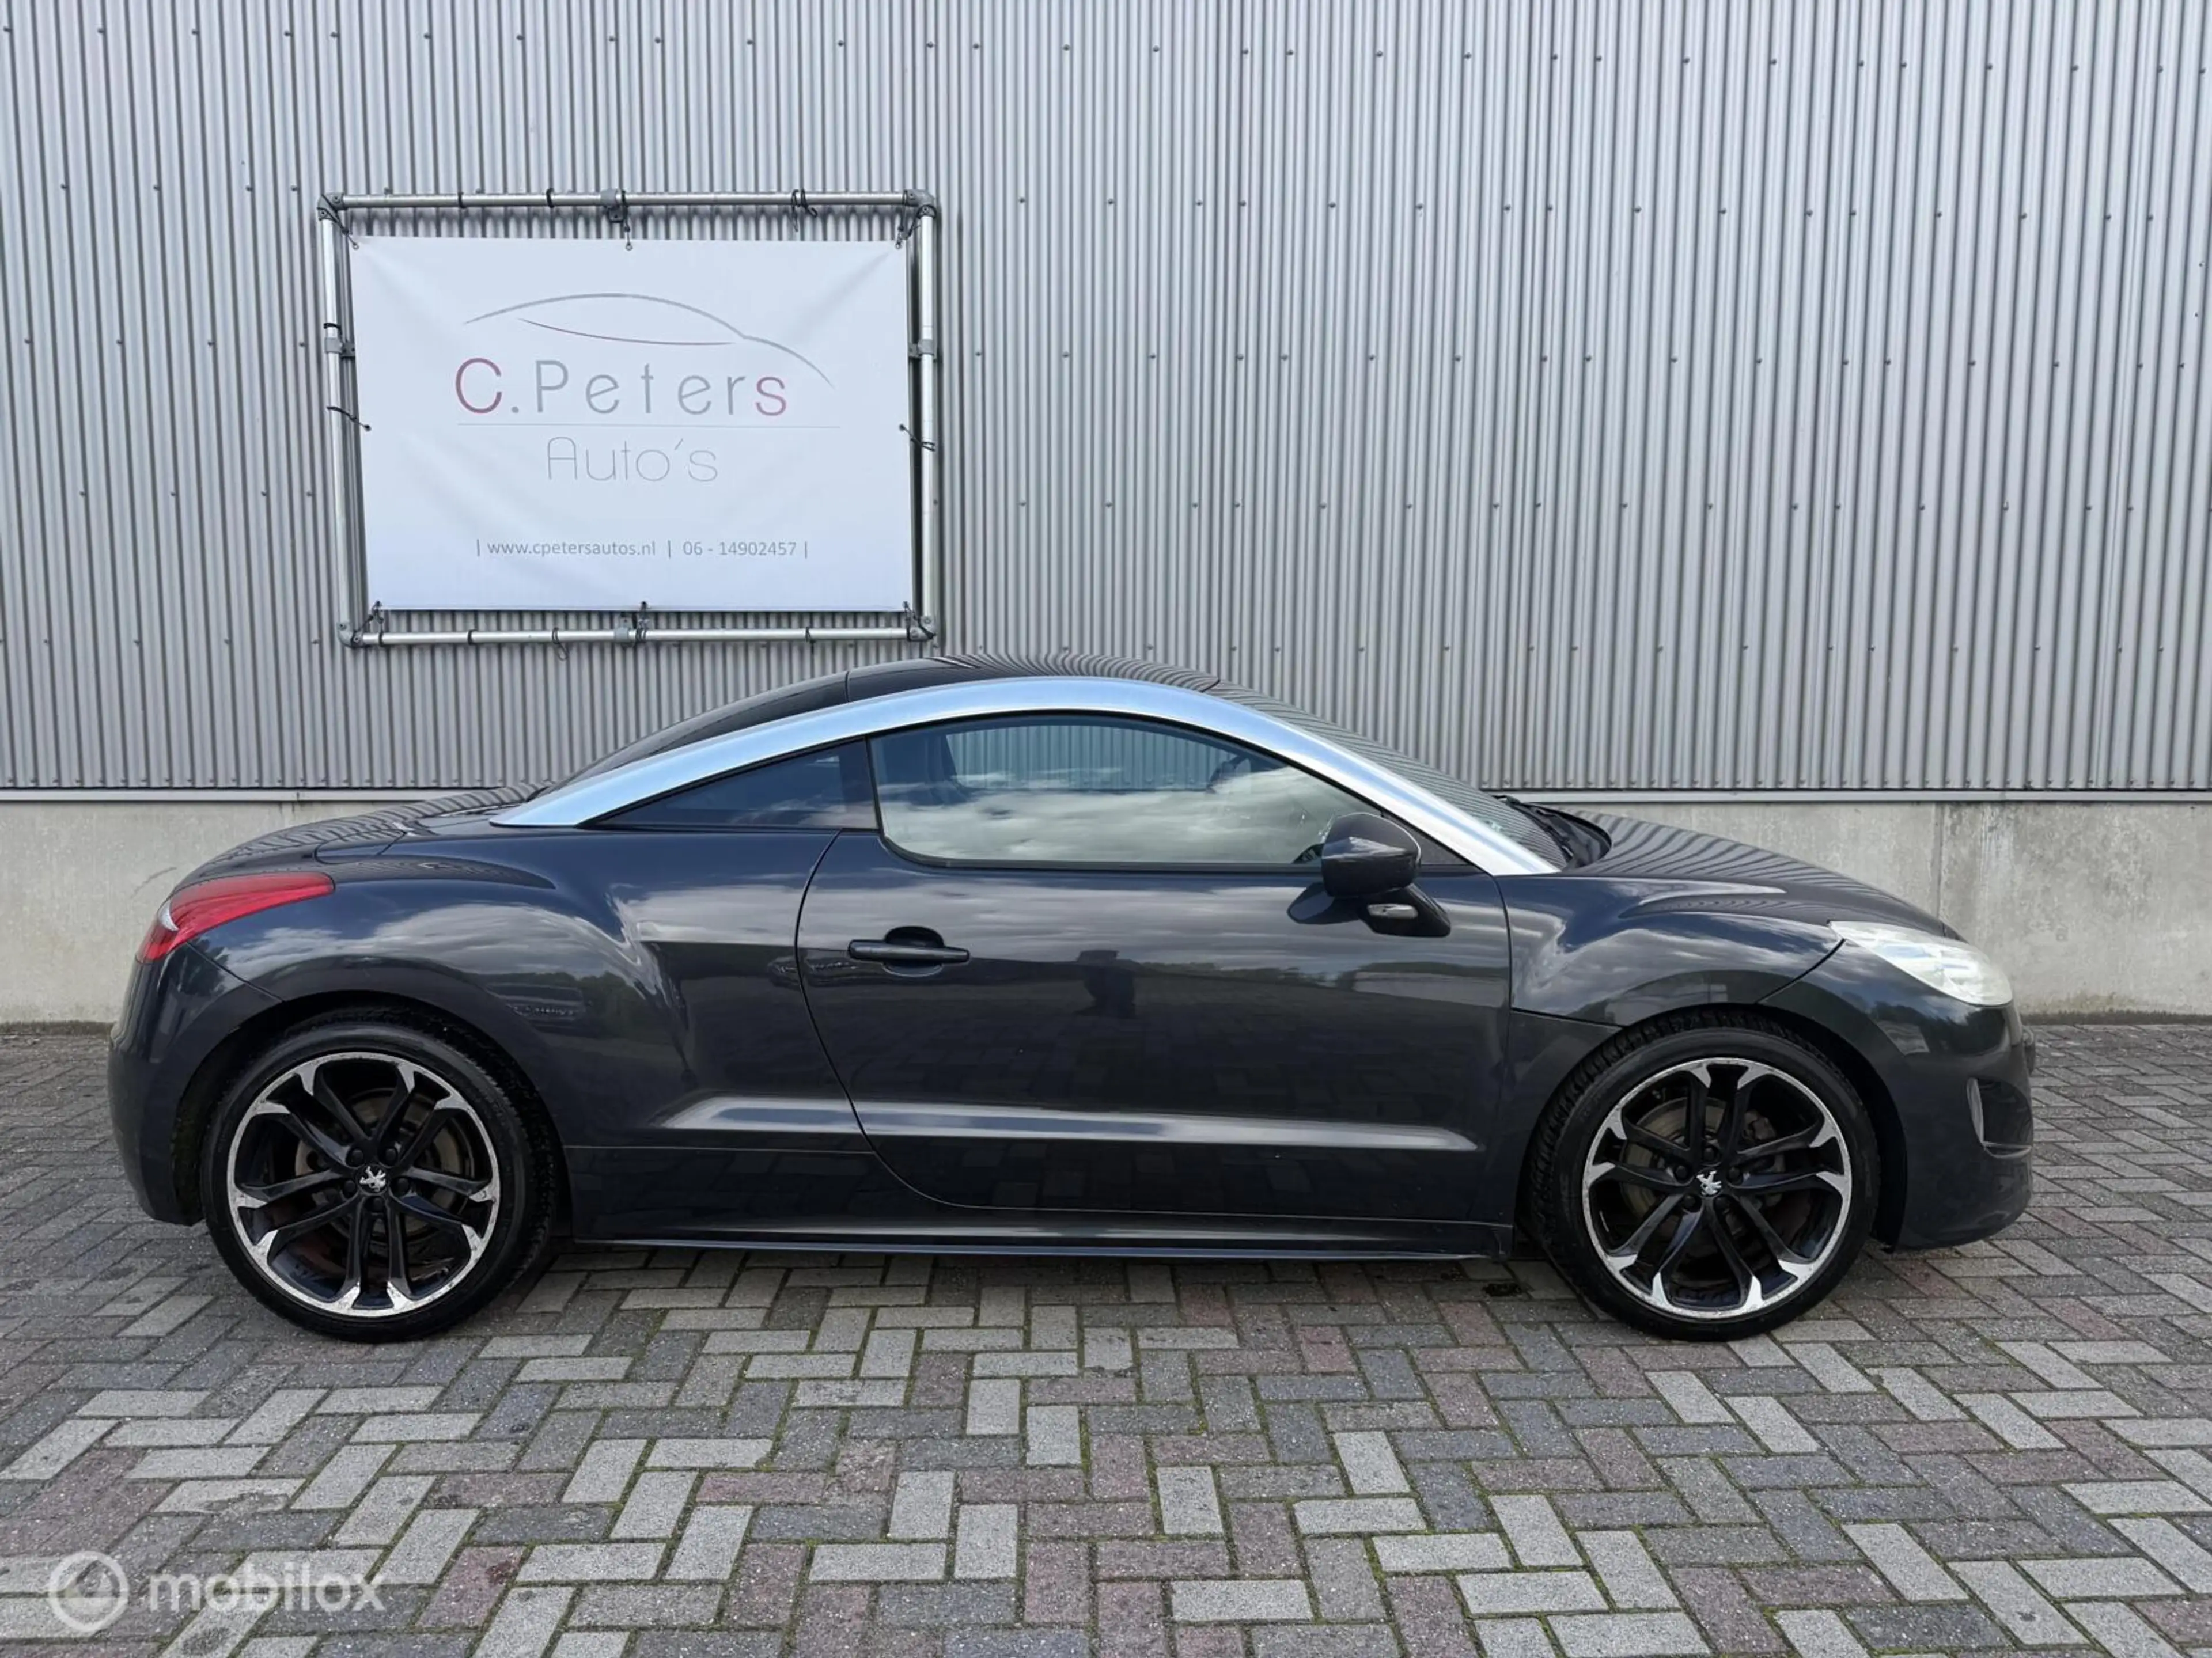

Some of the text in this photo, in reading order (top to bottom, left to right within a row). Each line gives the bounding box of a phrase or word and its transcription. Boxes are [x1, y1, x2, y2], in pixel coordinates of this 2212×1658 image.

[454, 357, 787, 416] C.Peters
[547, 436, 718, 483] Auto's
[487, 540, 656, 557] www.cpetersautos.nl
[683, 541, 703, 556] 06
[719, 541, 797, 556] 14902457
